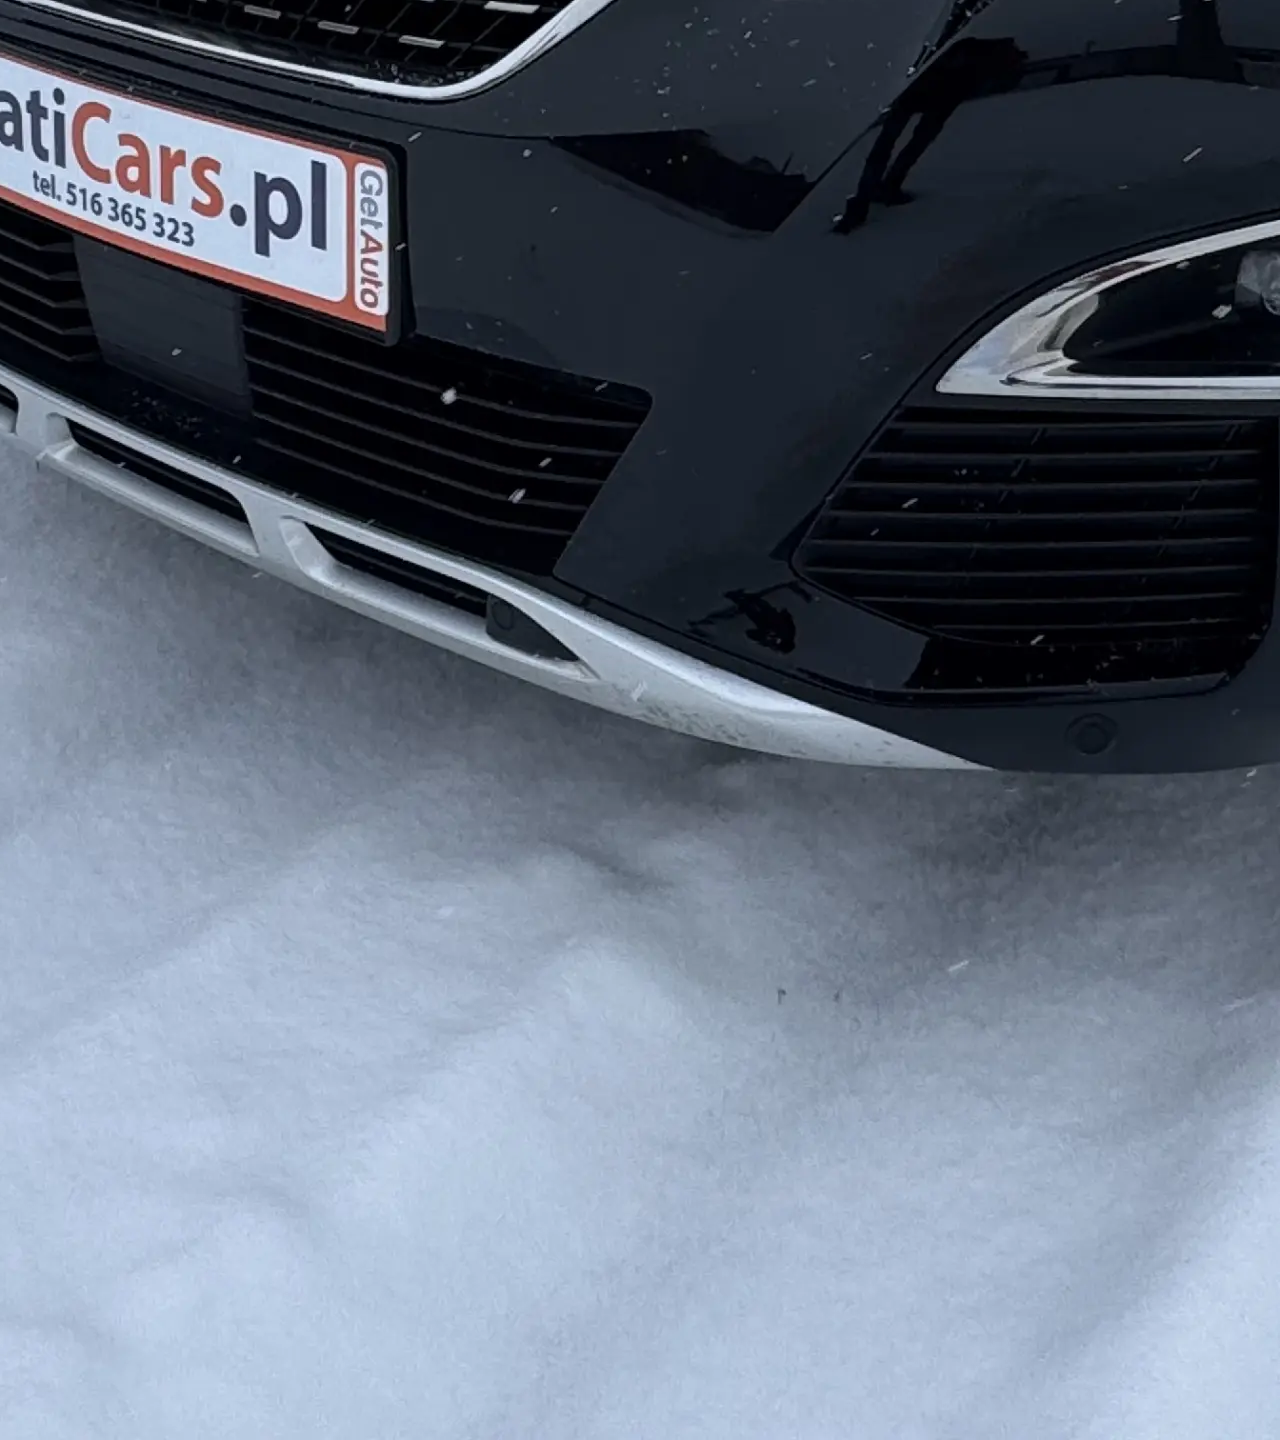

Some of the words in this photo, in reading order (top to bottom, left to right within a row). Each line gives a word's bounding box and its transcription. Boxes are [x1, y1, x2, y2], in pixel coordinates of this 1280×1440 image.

[32, 169, 62, 202] tel.
[65, 182, 104, 217] 516
[107, 196, 148, 232] 365
[152, 211, 196, 248] 323
[360, 169, 384, 309] GetAuto
